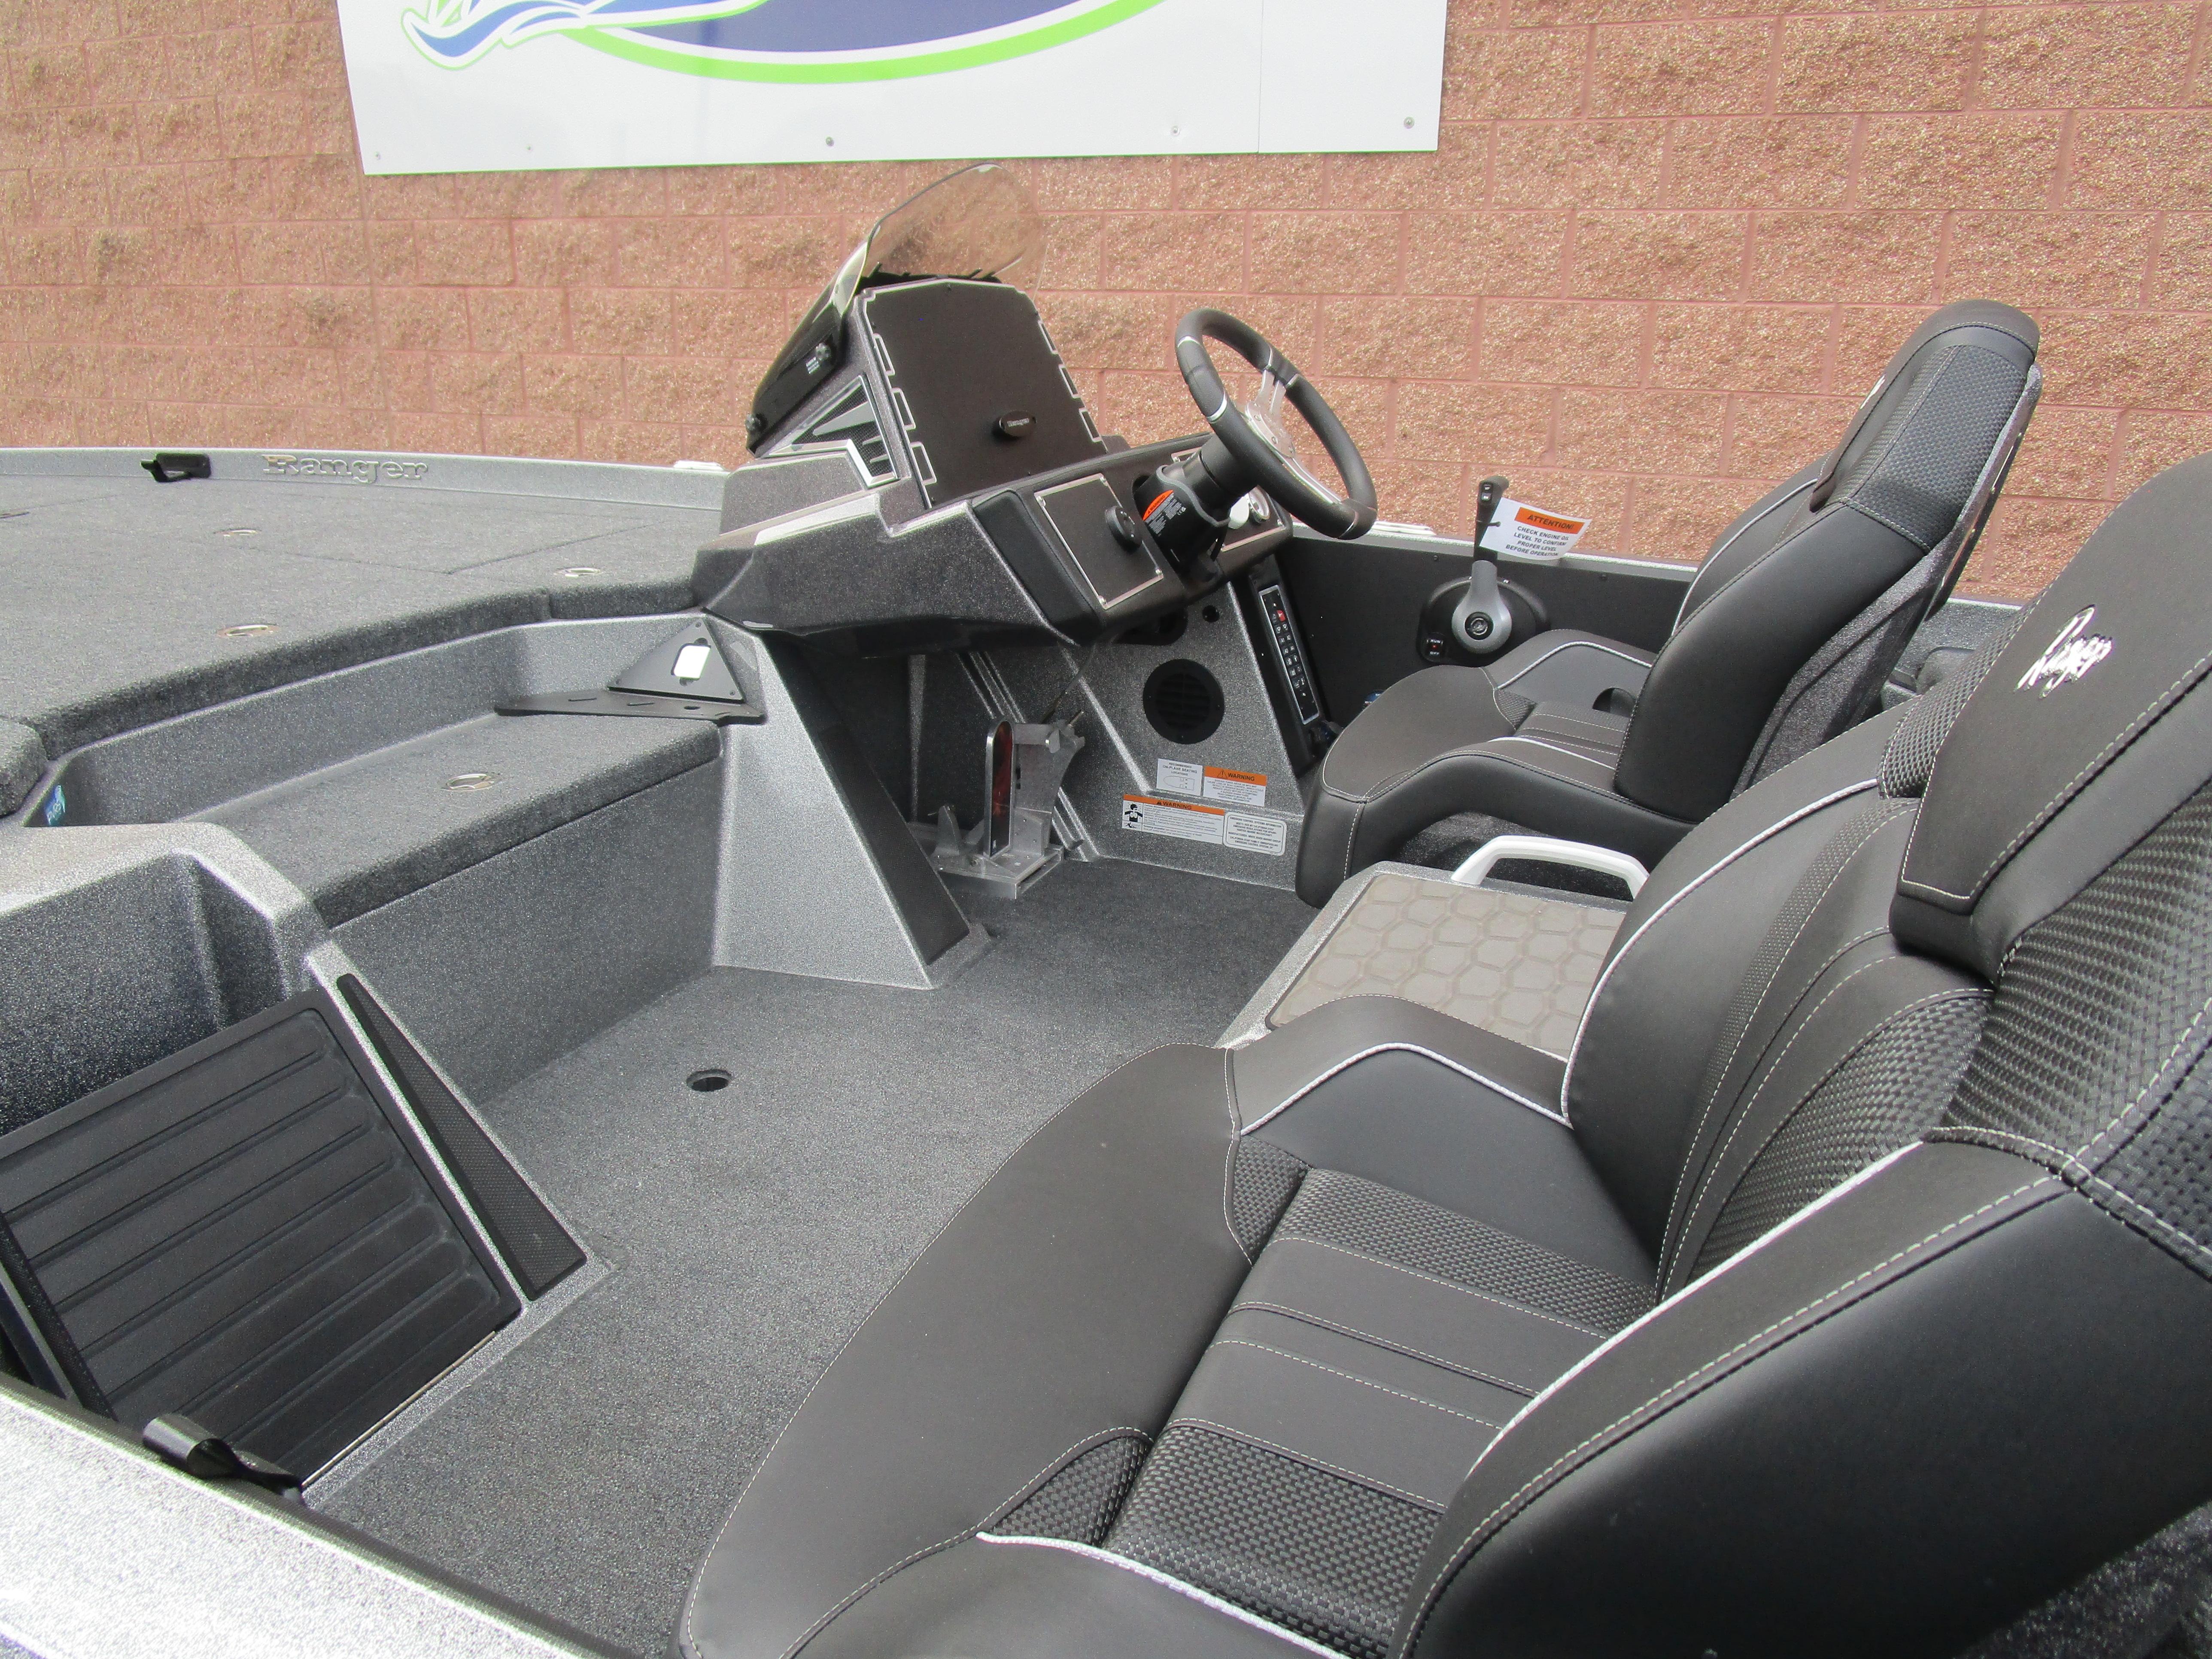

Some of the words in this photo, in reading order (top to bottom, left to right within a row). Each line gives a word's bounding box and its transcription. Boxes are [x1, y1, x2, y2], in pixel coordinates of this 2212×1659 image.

[261, 454, 428, 484] Ranger
[1527, 515, 1574, 529] ATTENTION!
[1517, 526, 1538, 535] CHECK
[1514, 532, 1532, 541] LEVEL
[1506, 544, 1530, 554] BEFORE
[1517, 540, 1541, 550] PROPER
[1228, 773, 1255, 781] WARNING
[1163, 802, 1192, 810] WARNING
